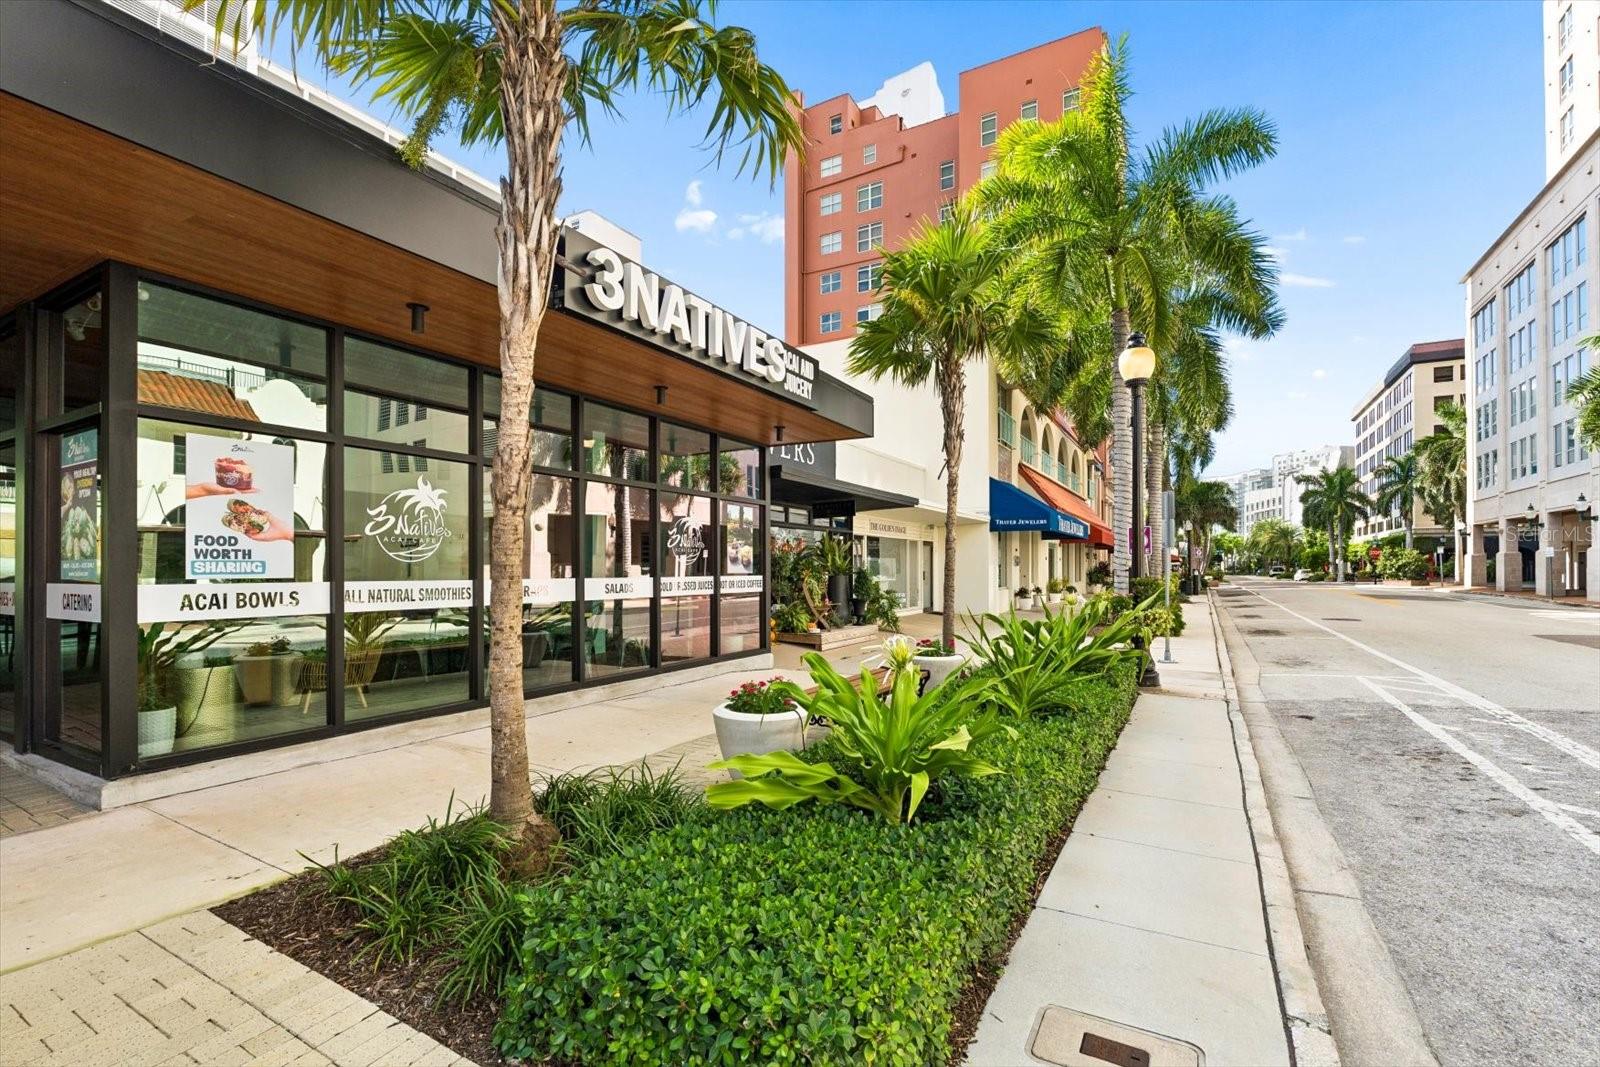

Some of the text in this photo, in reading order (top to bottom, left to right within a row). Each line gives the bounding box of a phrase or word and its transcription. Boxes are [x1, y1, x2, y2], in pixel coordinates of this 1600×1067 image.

[585, 248, 786, 383] 3NATIVES
[800, 358, 814, 381] AND
[784, 372, 813, 400] JUICERY
[194, 534, 239, 547] FOOD
[194, 548, 252, 560] WORTH
[193, 561, 263, 574] SHARING
[604, 582, 634, 595] SALADS
[720, 580, 728, 590] OT
[747, 578, 763, 588] COFFEE
[62, 593, 93, 612] CATERING
[180, 590, 300, 611] ACAI BOWLS
[344, 586, 472, 603] ALL NATURAL SMOOTHIES
